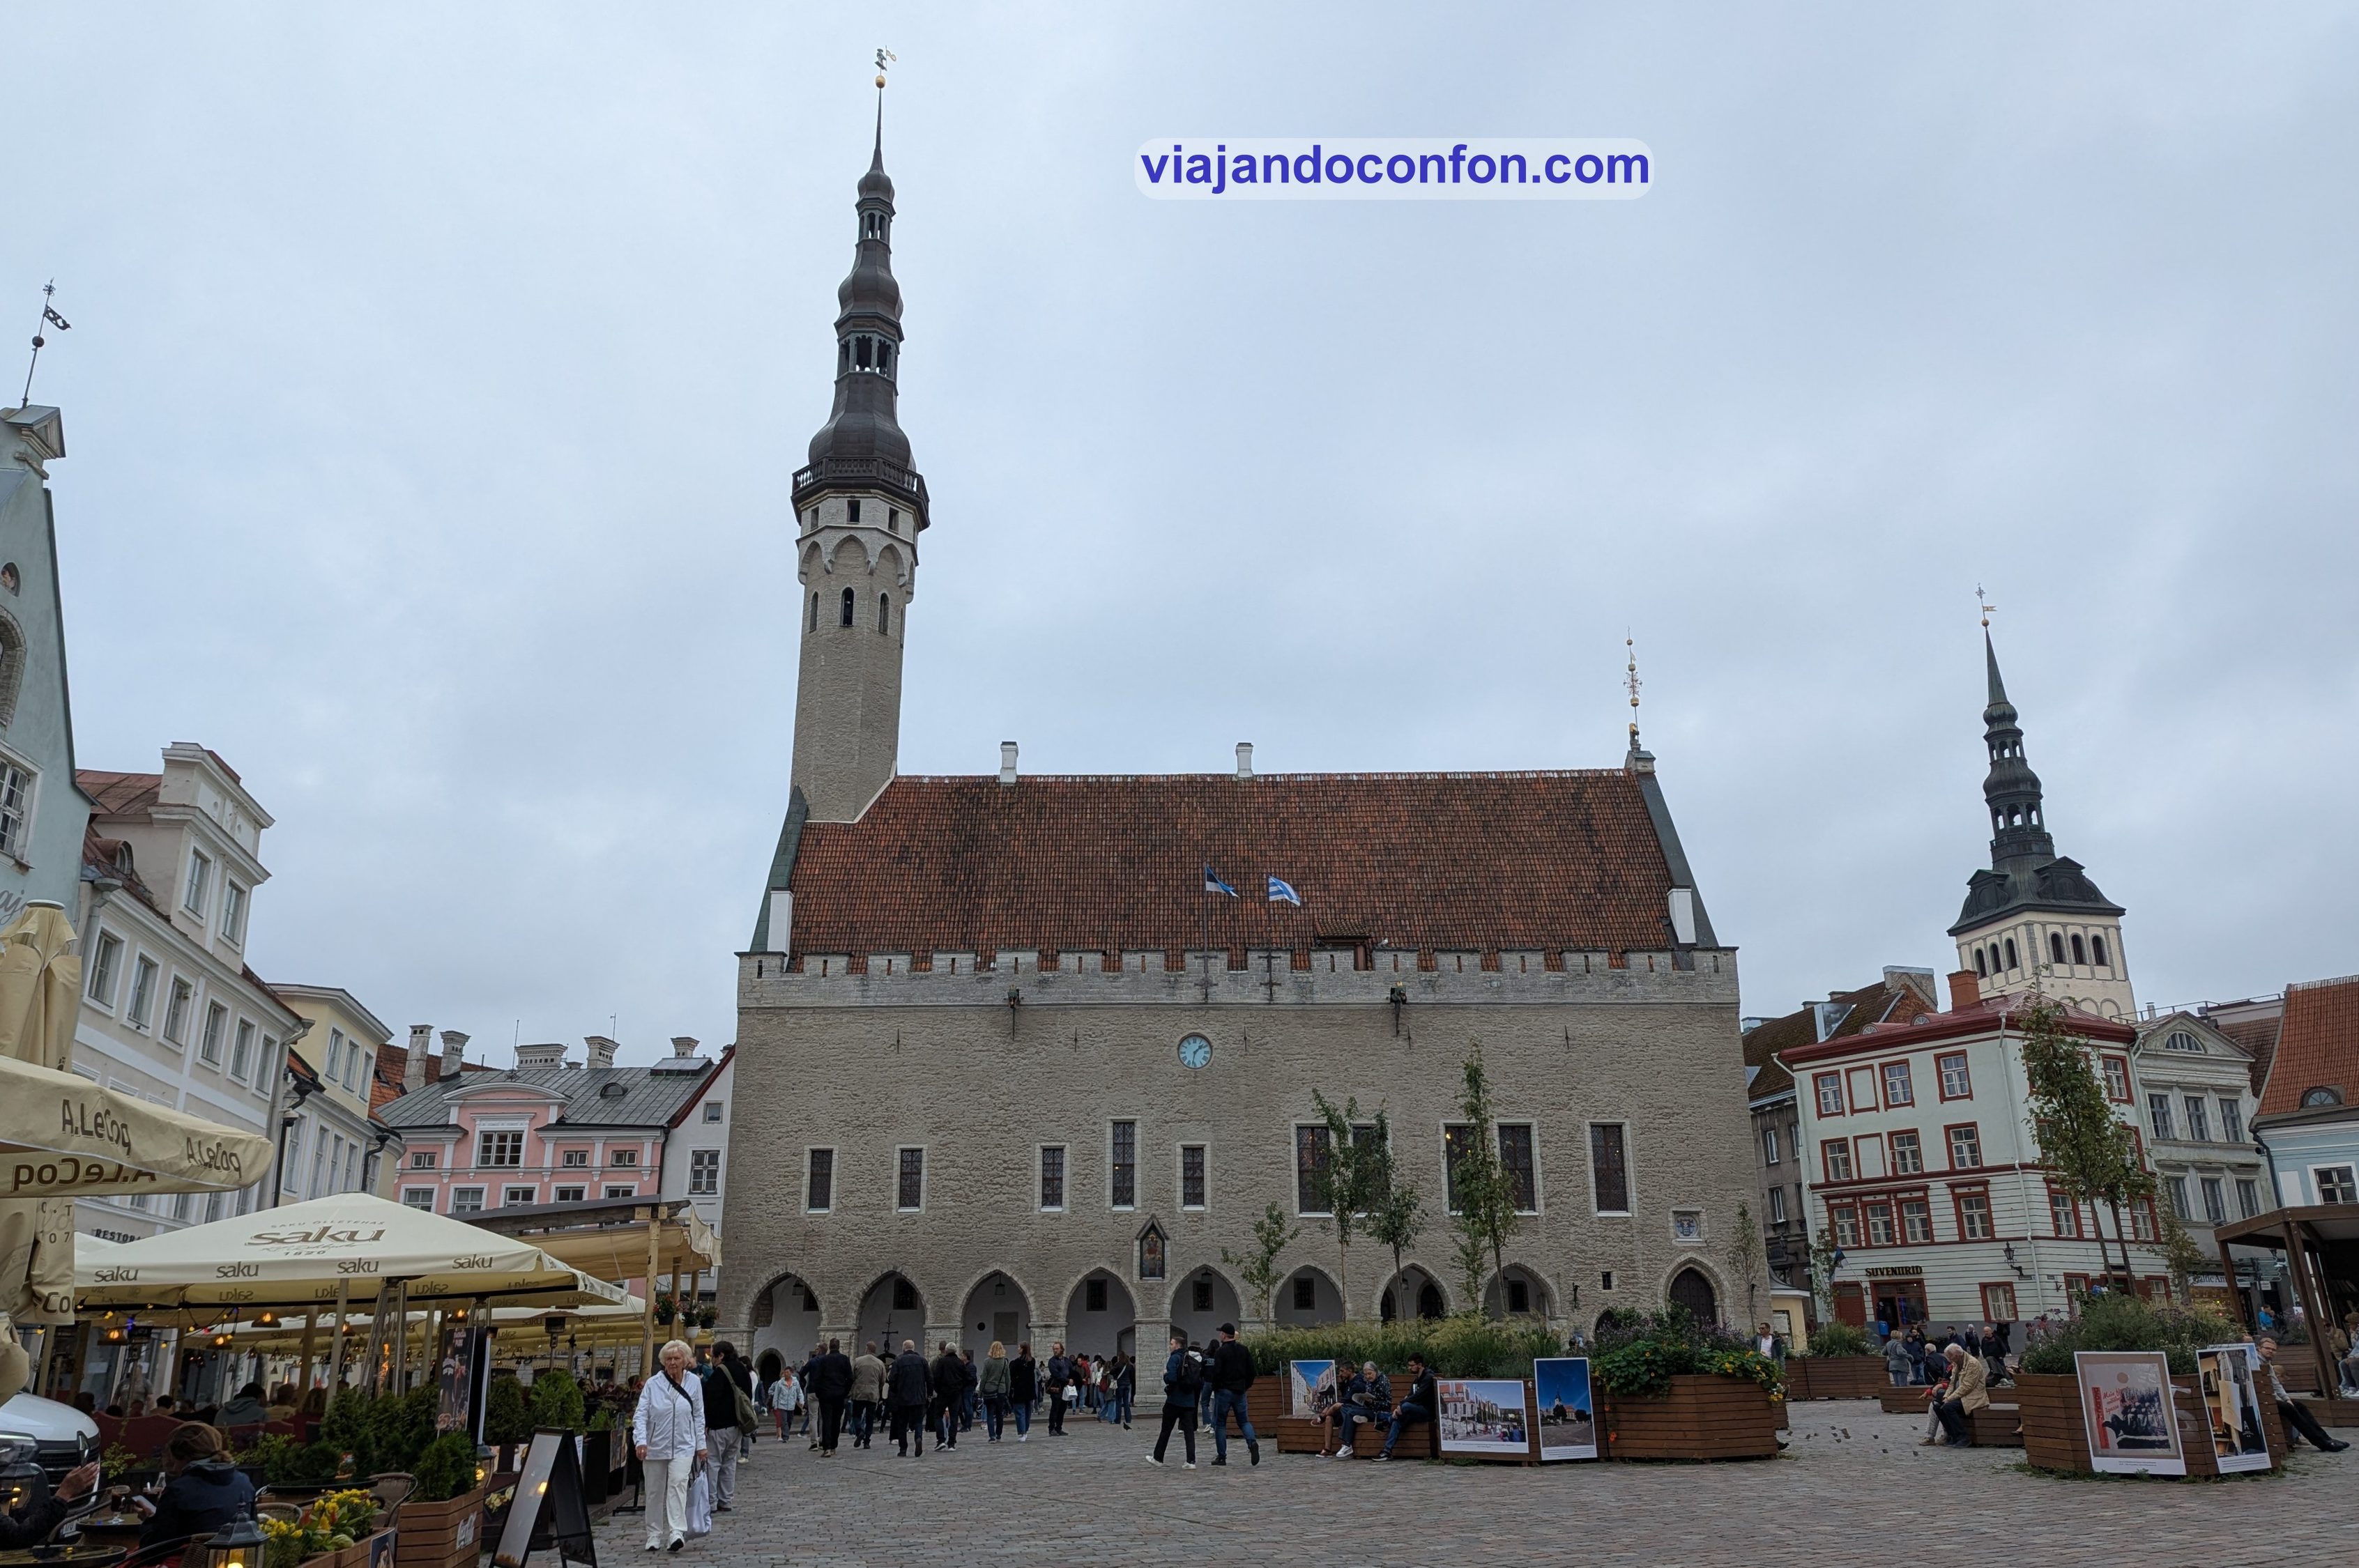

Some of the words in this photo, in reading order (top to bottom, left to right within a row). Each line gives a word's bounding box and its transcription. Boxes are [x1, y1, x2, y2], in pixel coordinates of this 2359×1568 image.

[245, 1226, 385, 1245] saku
[216, 1261, 259, 1278] saku
[337, 1257, 379, 1274] saku
[452, 1254, 493, 1269] saku
[94, 1266, 139, 1282] saku
[1865, 1265, 1923, 1277] SUVENIIRID
